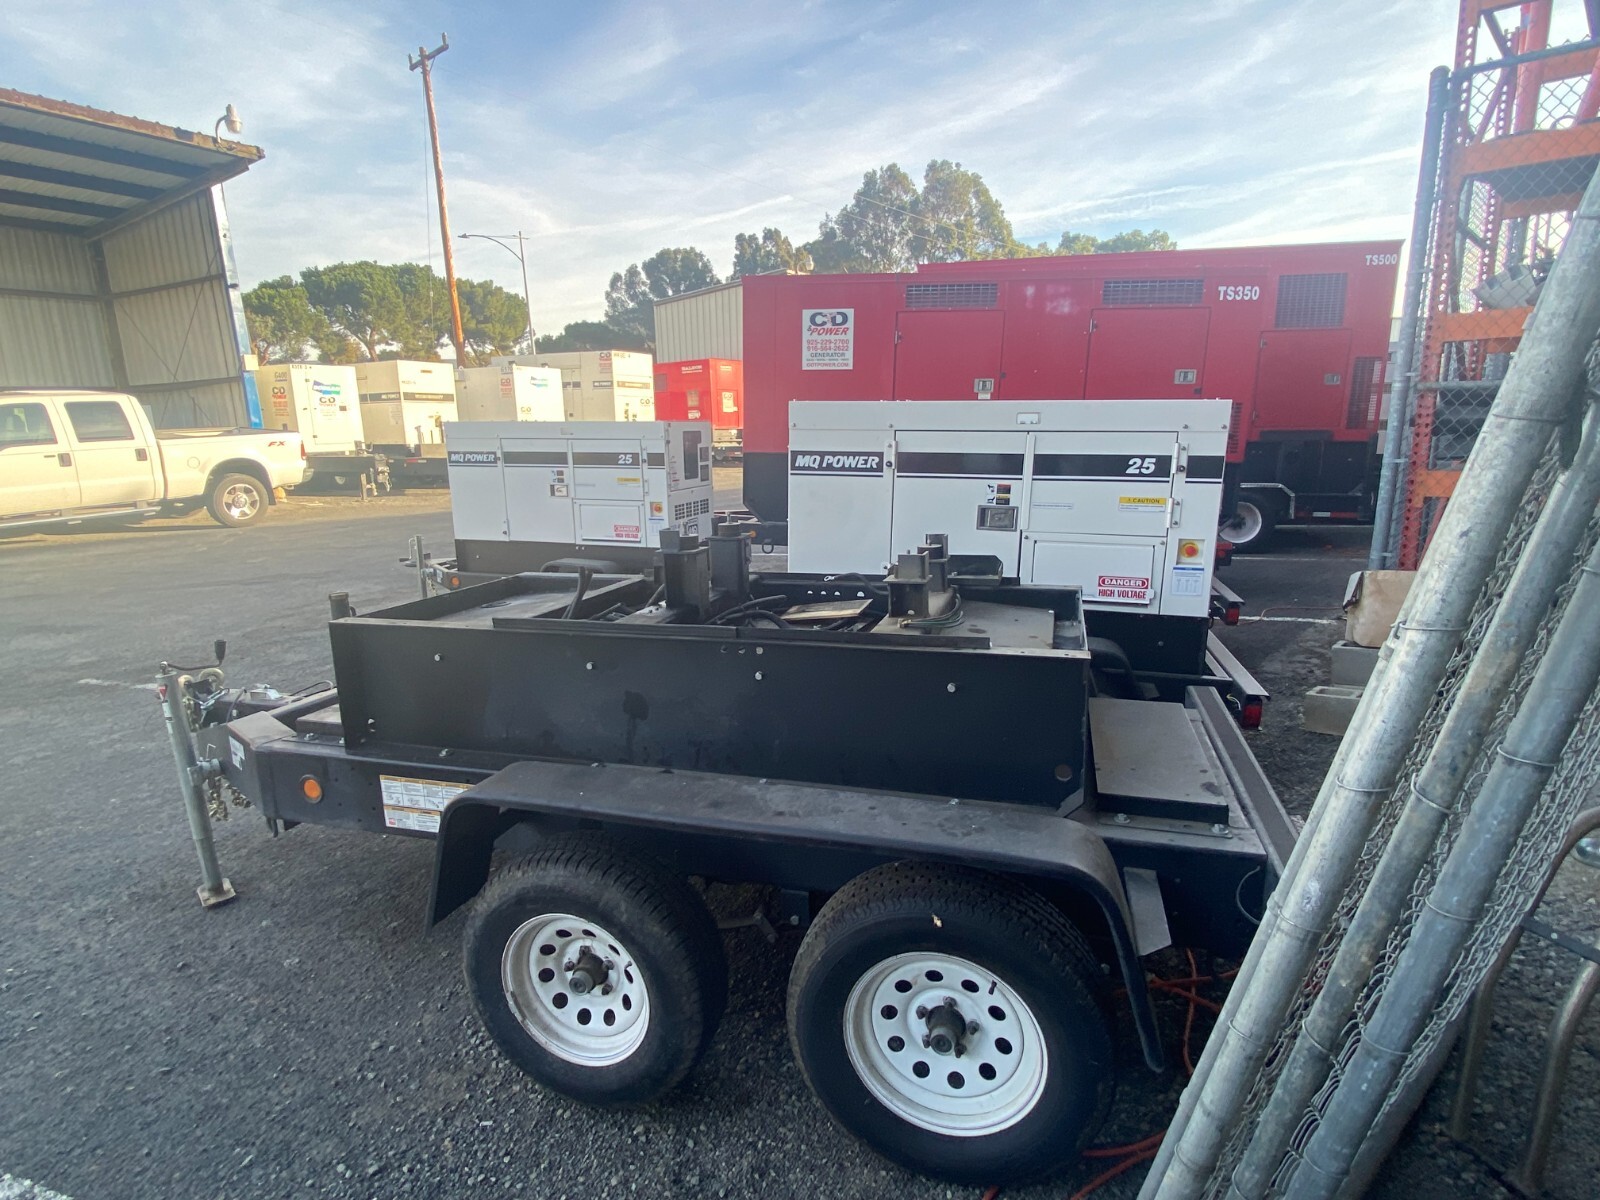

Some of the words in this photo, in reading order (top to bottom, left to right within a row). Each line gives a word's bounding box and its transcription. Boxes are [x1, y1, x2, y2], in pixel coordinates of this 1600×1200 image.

[1365, 253, 1398, 266] TS500
[1218, 285, 1260, 301] TS350
[810, 327, 850, 336] POWER
[450, 453, 464, 463] MQ
[465, 453, 495, 462] POWER
[617, 454, 633, 464] 25
[795, 455, 820, 469] MQ
[822, 455, 880, 469] POWER
[1125, 457, 1156, 474] 25
[1104, 578, 1143, 587] DANGER
[1098, 588, 1115, 598] HIGH
[1117, 589, 1147, 600] VOLTAGE
